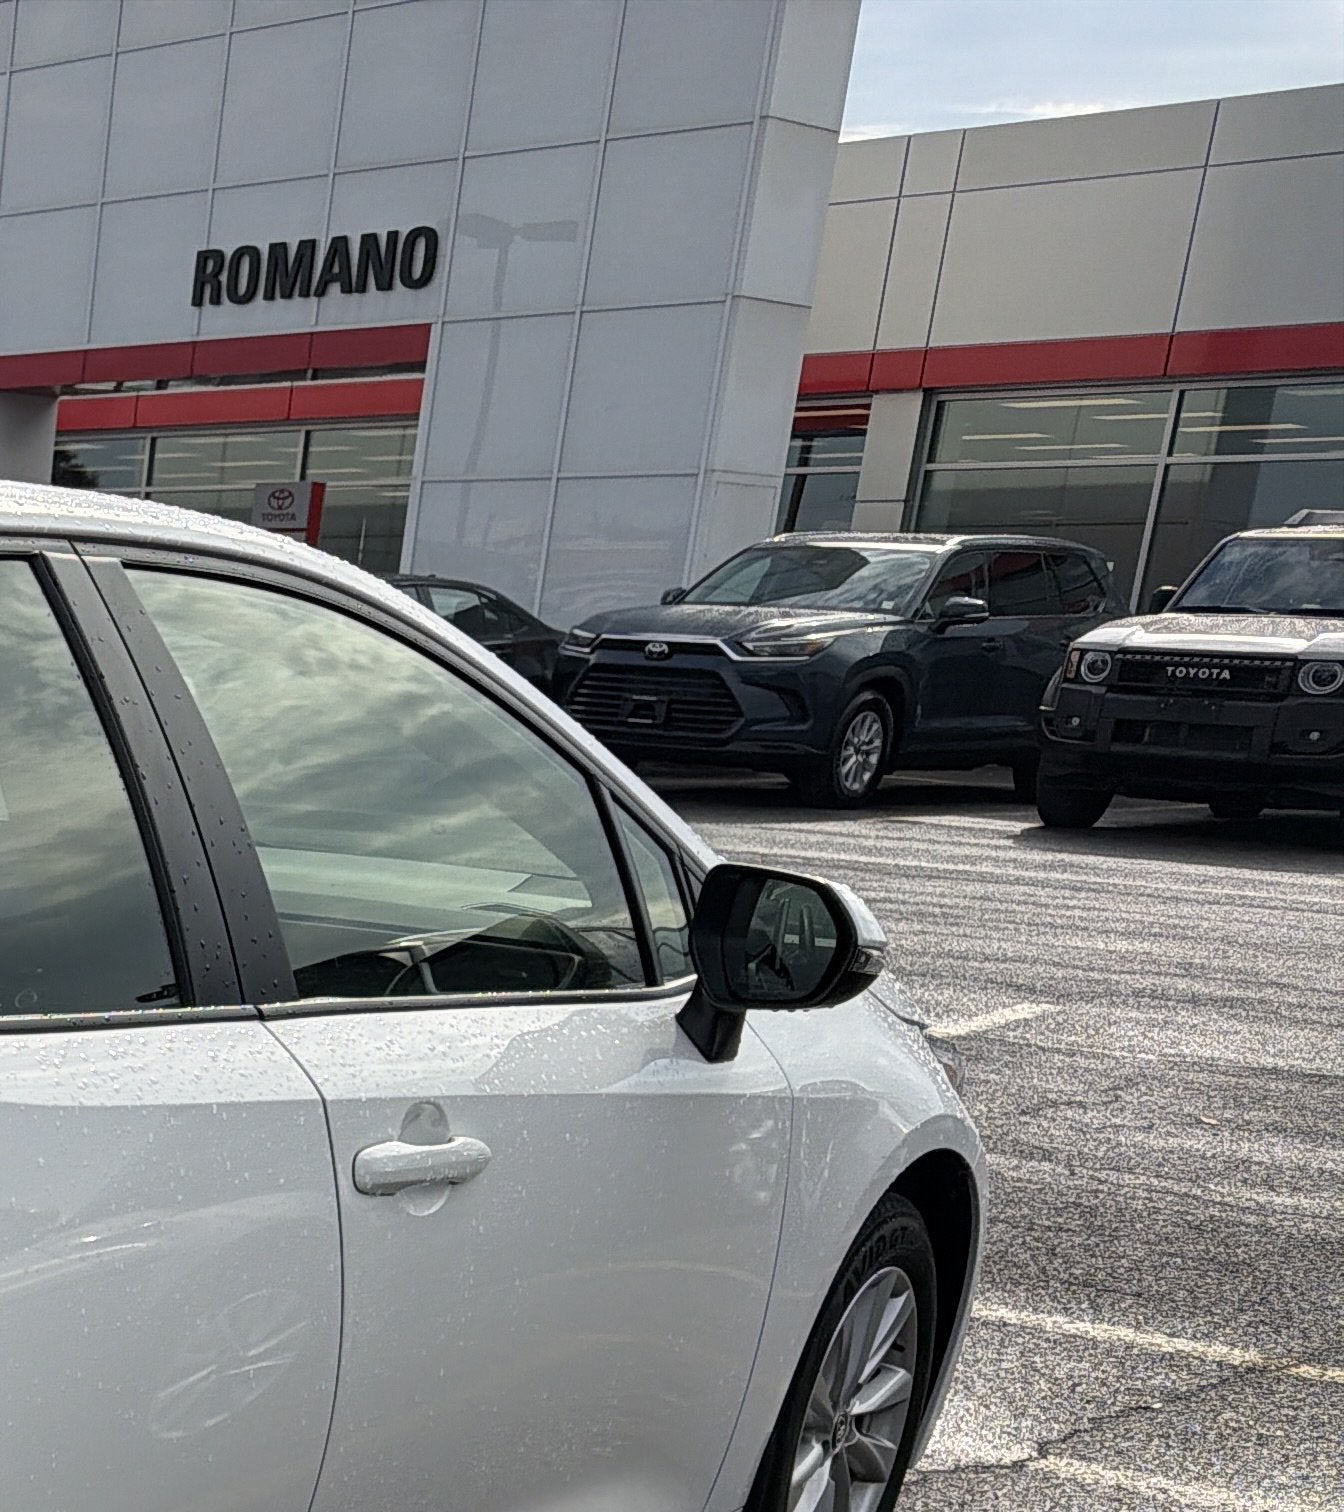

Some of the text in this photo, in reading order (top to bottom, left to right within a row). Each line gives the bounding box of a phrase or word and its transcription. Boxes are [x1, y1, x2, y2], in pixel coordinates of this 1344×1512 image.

[191, 226, 439, 307] ROMANO
[262, 512, 296, 522] TOYOTA
[1165, 666, 1231, 680] TOYOTA
